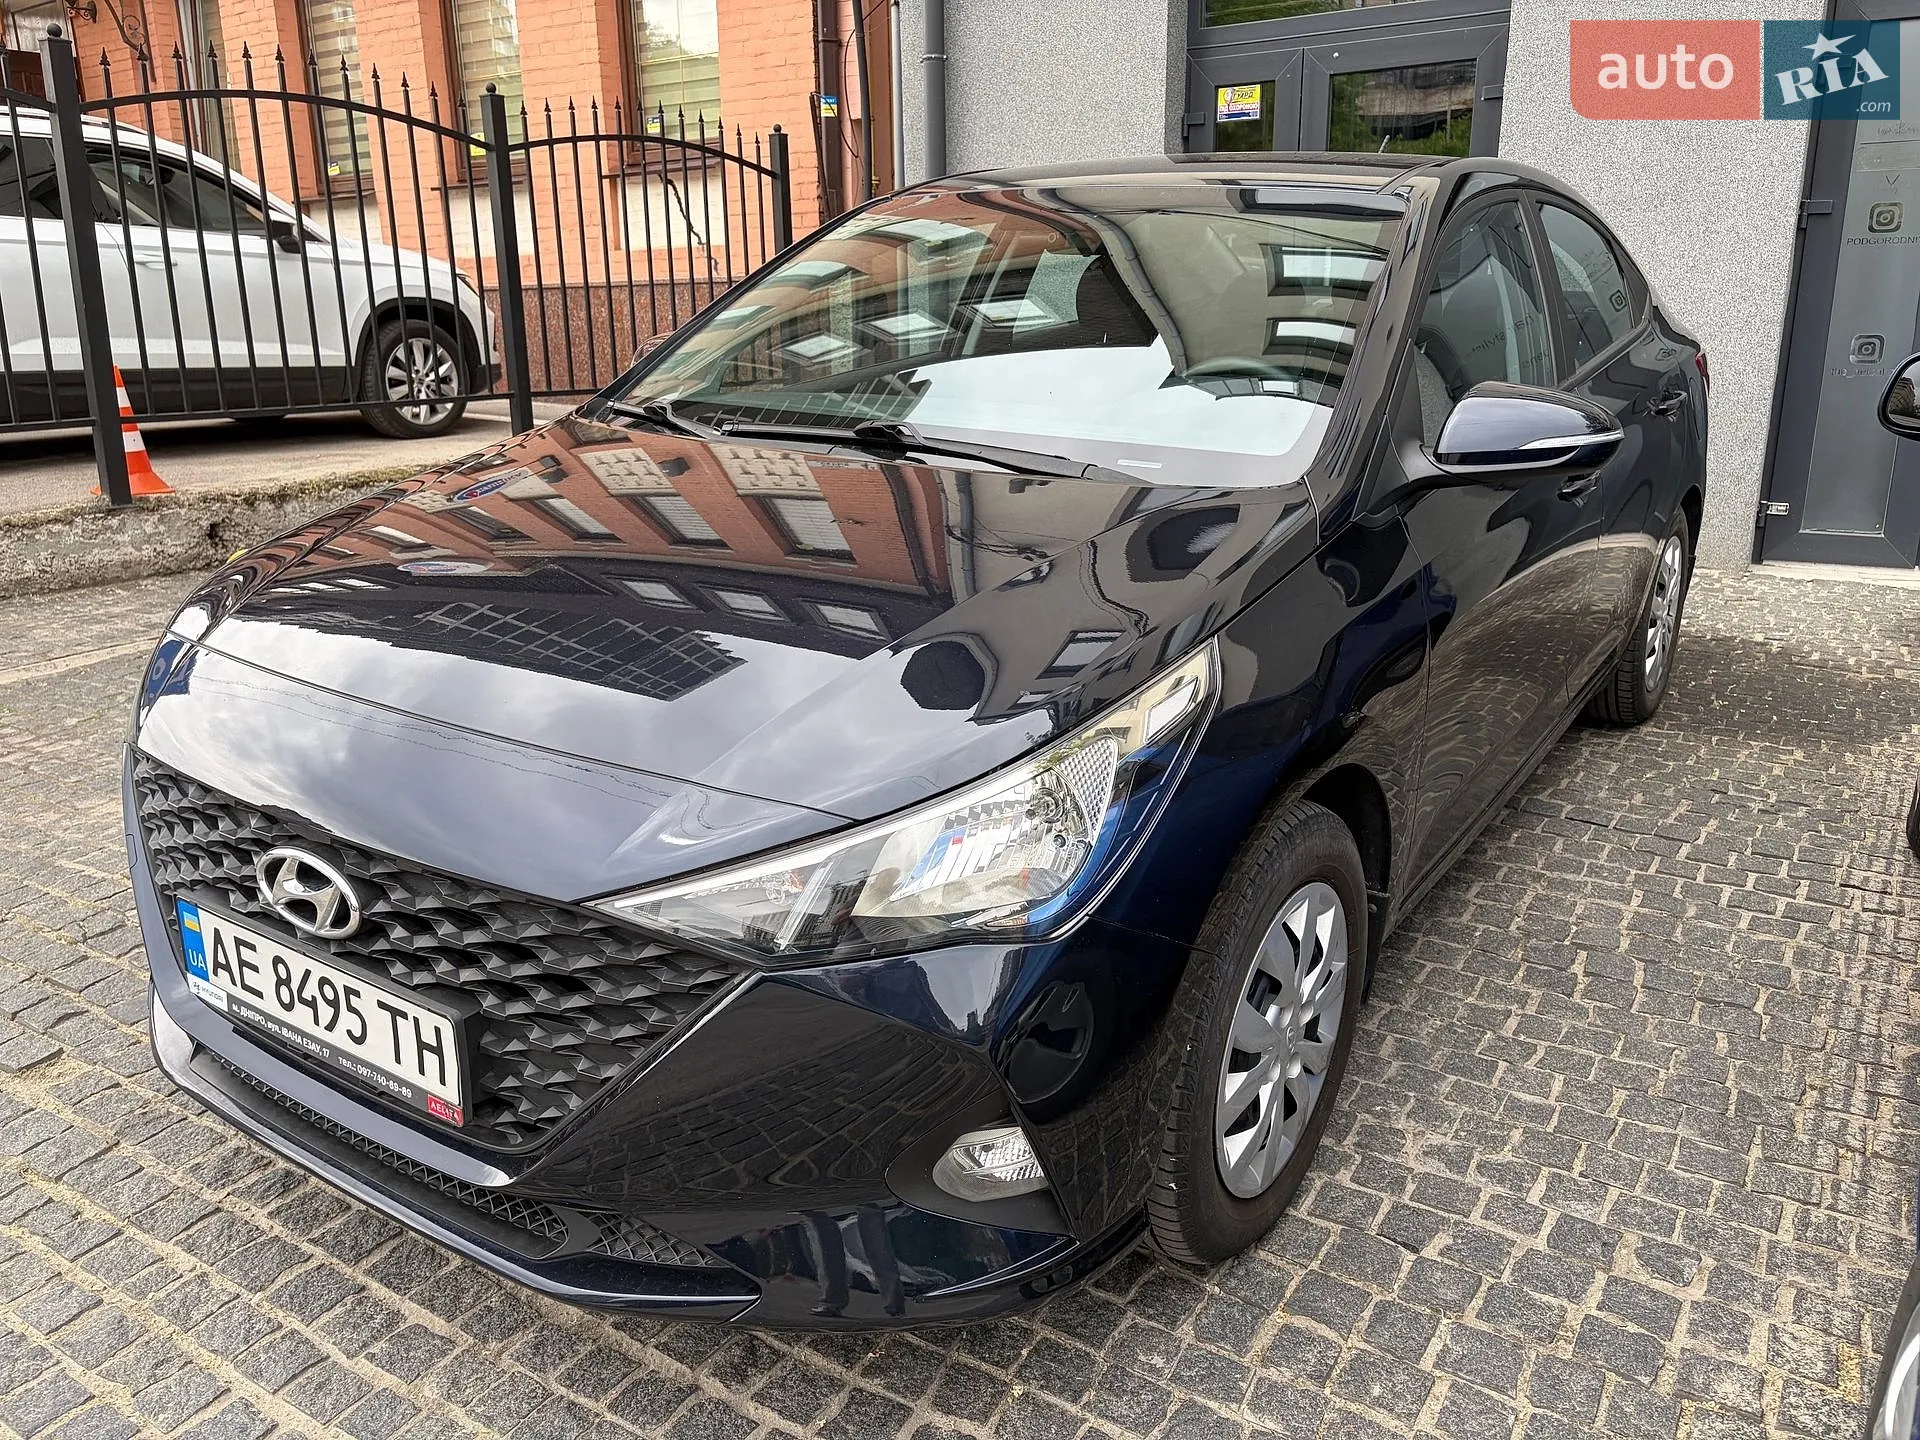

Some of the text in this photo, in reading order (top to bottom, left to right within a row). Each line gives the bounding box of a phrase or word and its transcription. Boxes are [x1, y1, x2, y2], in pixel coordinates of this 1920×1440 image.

[1846, 235, 1920, 246] PODGORODNI
[188, 949, 207, 971] UA
[212, 927, 447, 1087] AE 8495 TH
